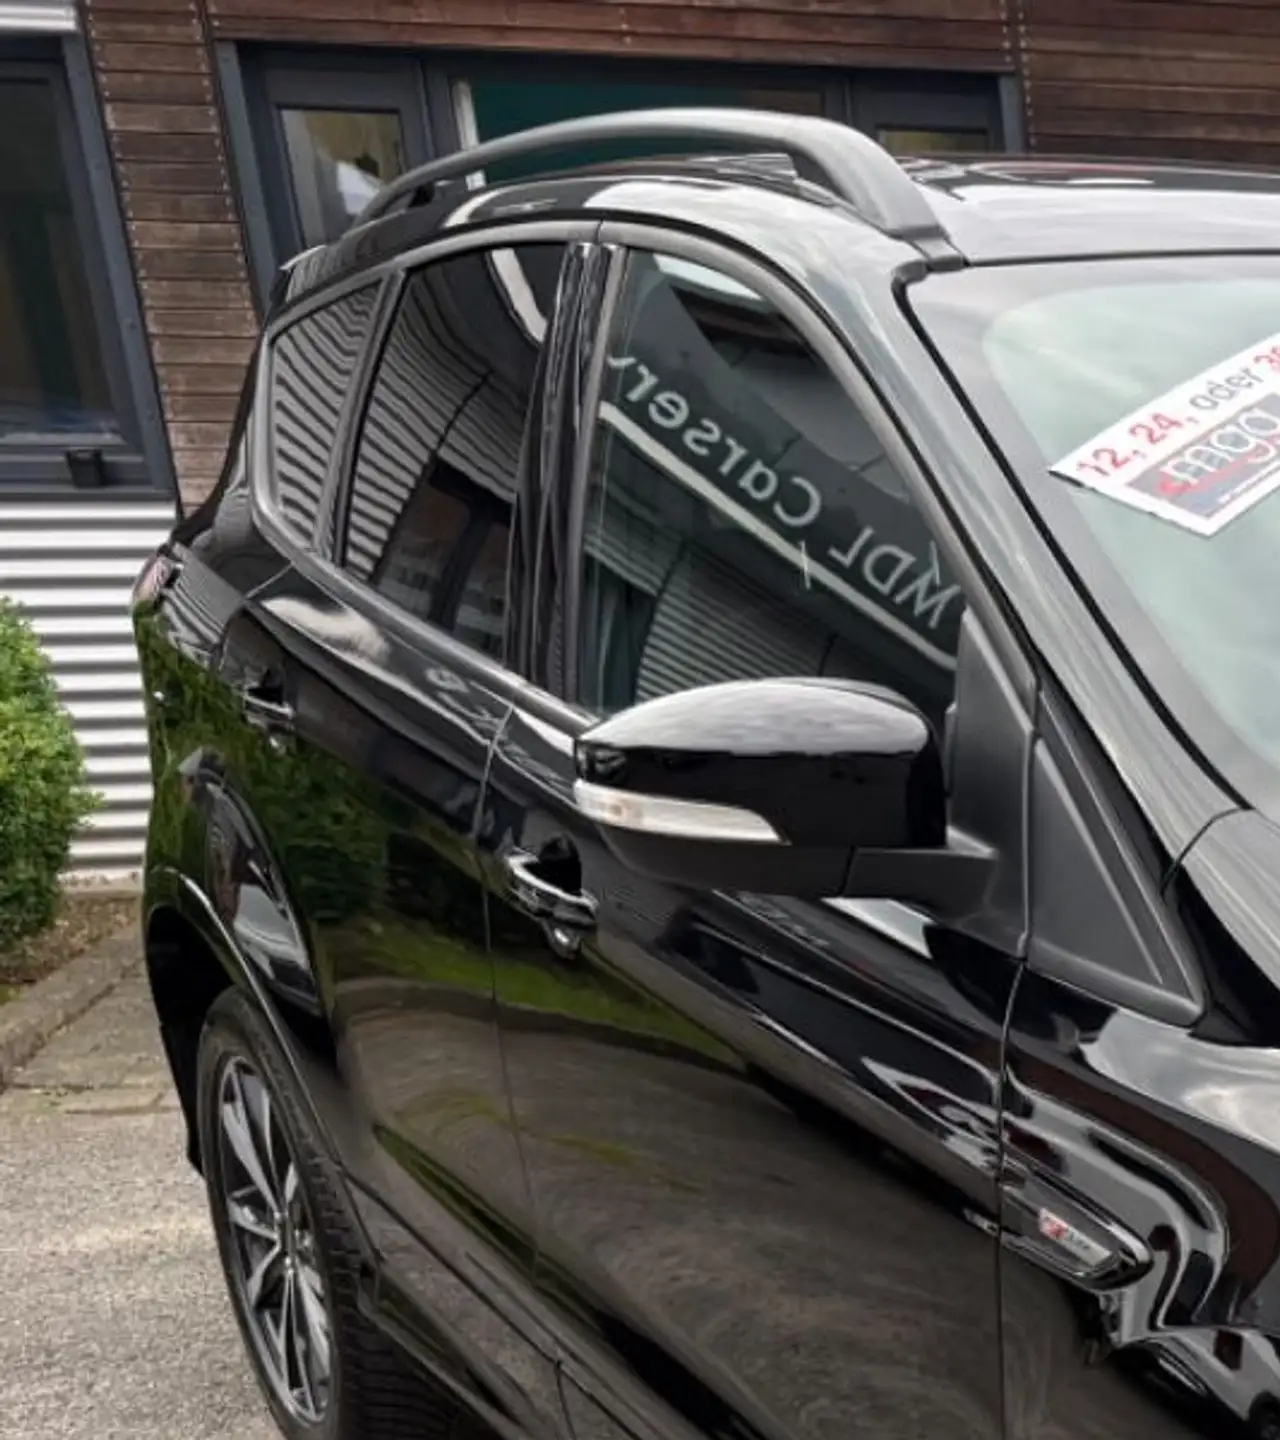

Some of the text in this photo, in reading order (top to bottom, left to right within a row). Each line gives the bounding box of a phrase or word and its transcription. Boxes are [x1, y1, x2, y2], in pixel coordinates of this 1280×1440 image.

[1076, 446, 1147, 478] 12,
[1128, 411, 1199, 446] 24,
[1188, 366, 1265, 411] oder
